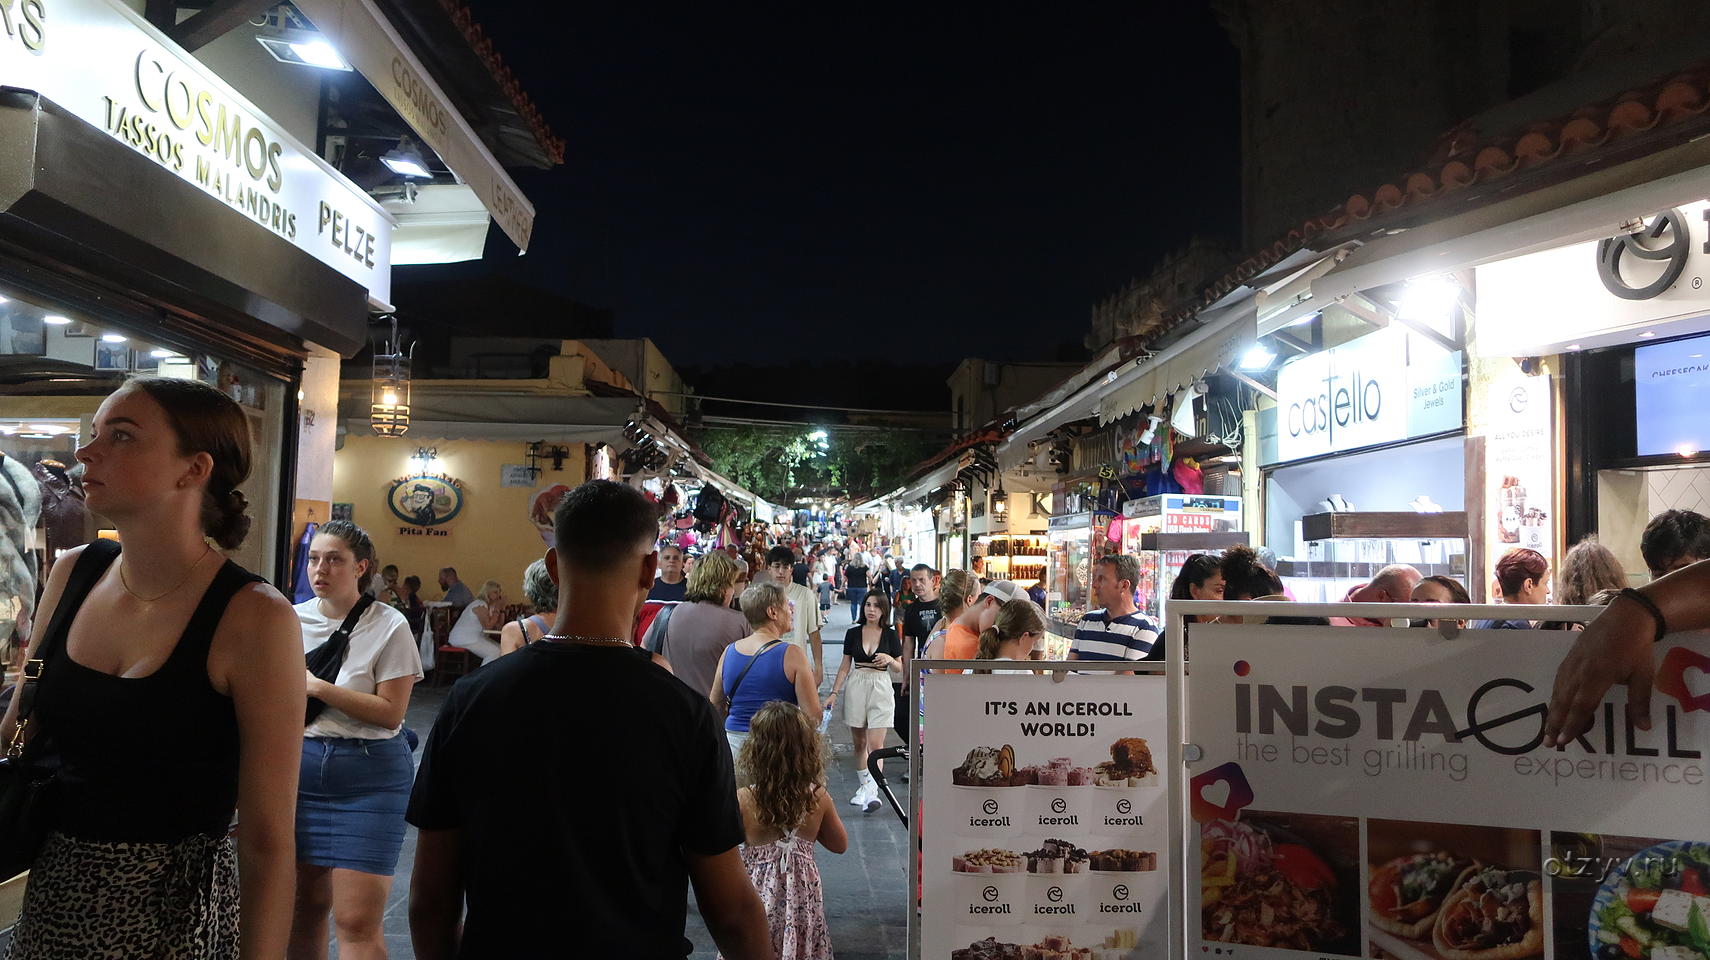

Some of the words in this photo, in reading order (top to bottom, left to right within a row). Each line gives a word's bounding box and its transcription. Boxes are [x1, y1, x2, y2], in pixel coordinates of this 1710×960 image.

[391, 56, 448, 136] COSMOS
[134, 48, 283, 194] COSMOS
[102, 95, 184, 172] TASSOS
[195, 155, 297, 242] MALANDRIS
[318, 200, 376, 270] PELZE
[1412, 387, 1432, 399] Silver
[1432, 384, 1438, 393] &
[1438, 379, 1456, 393] Gold
[1289, 349, 1381, 447] castello
[1423, 395, 1445, 410] Jewels
[1182, 515, 1210, 526] CARDS
[400, 527, 422, 536] Pita
[425, 528, 448, 536] Fan
[985, 701, 1018, 716] IT'S
[1025, 702, 1050, 716] AN
[1056, 702, 1133, 717] ICEROLL
[1020, 722, 1095, 737] WORLD!
[1236, 732, 1279, 764] the
[1292, 735, 1351, 767] best
[1363, 738, 1469, 782] grilling
[1513, 752, 1704, 786] experience
[969, 816, 1011, 827] iceroll
[1038, 815, 1079, 826] iceroll
[1104, 815, 1144, 826] iceroll
[969, 903, 1011, 915] iceroll
[1034, 903, 1076, 915] iceroll
[1100, 902, 1142, 914] iceroll
